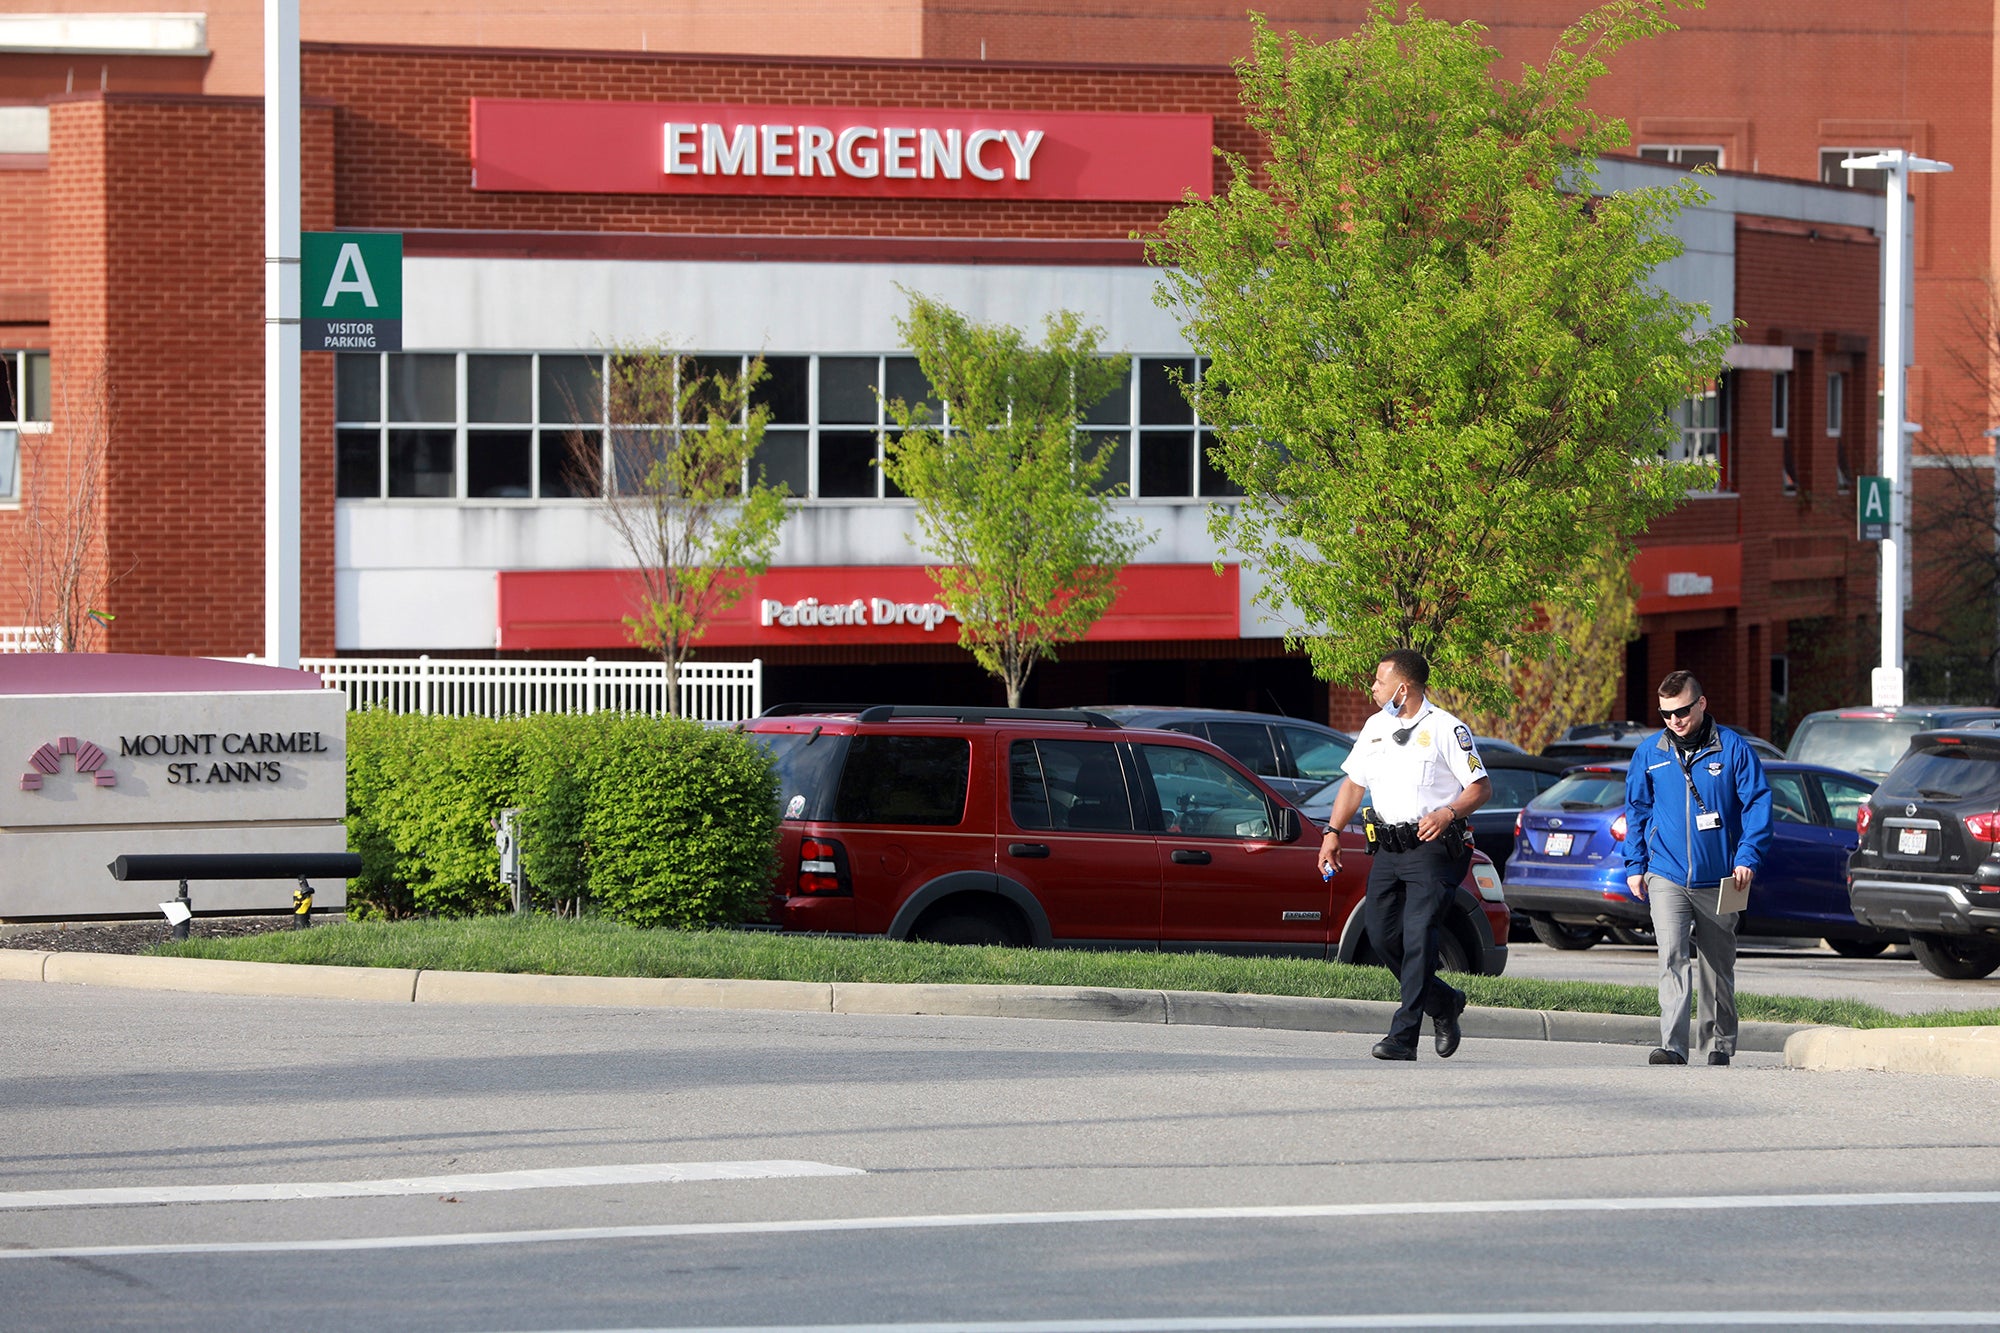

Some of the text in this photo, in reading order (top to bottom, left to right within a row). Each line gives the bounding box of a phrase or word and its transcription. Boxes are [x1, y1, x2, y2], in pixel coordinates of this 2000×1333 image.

[663, 122, 1044, 181] EMERGENCY
[321, 243, 379, 307] A
[324, 336, 376, 348] PARKING
[327, 323, 374, 334] VISITOR
[1865, 481, 1883, 517] A
[761, 597, 997, 631] Patient Drop-
[120, 732, 328, 757] MOUNT CARMEL
[167, 761, 281, 784] ST. ANN'S
